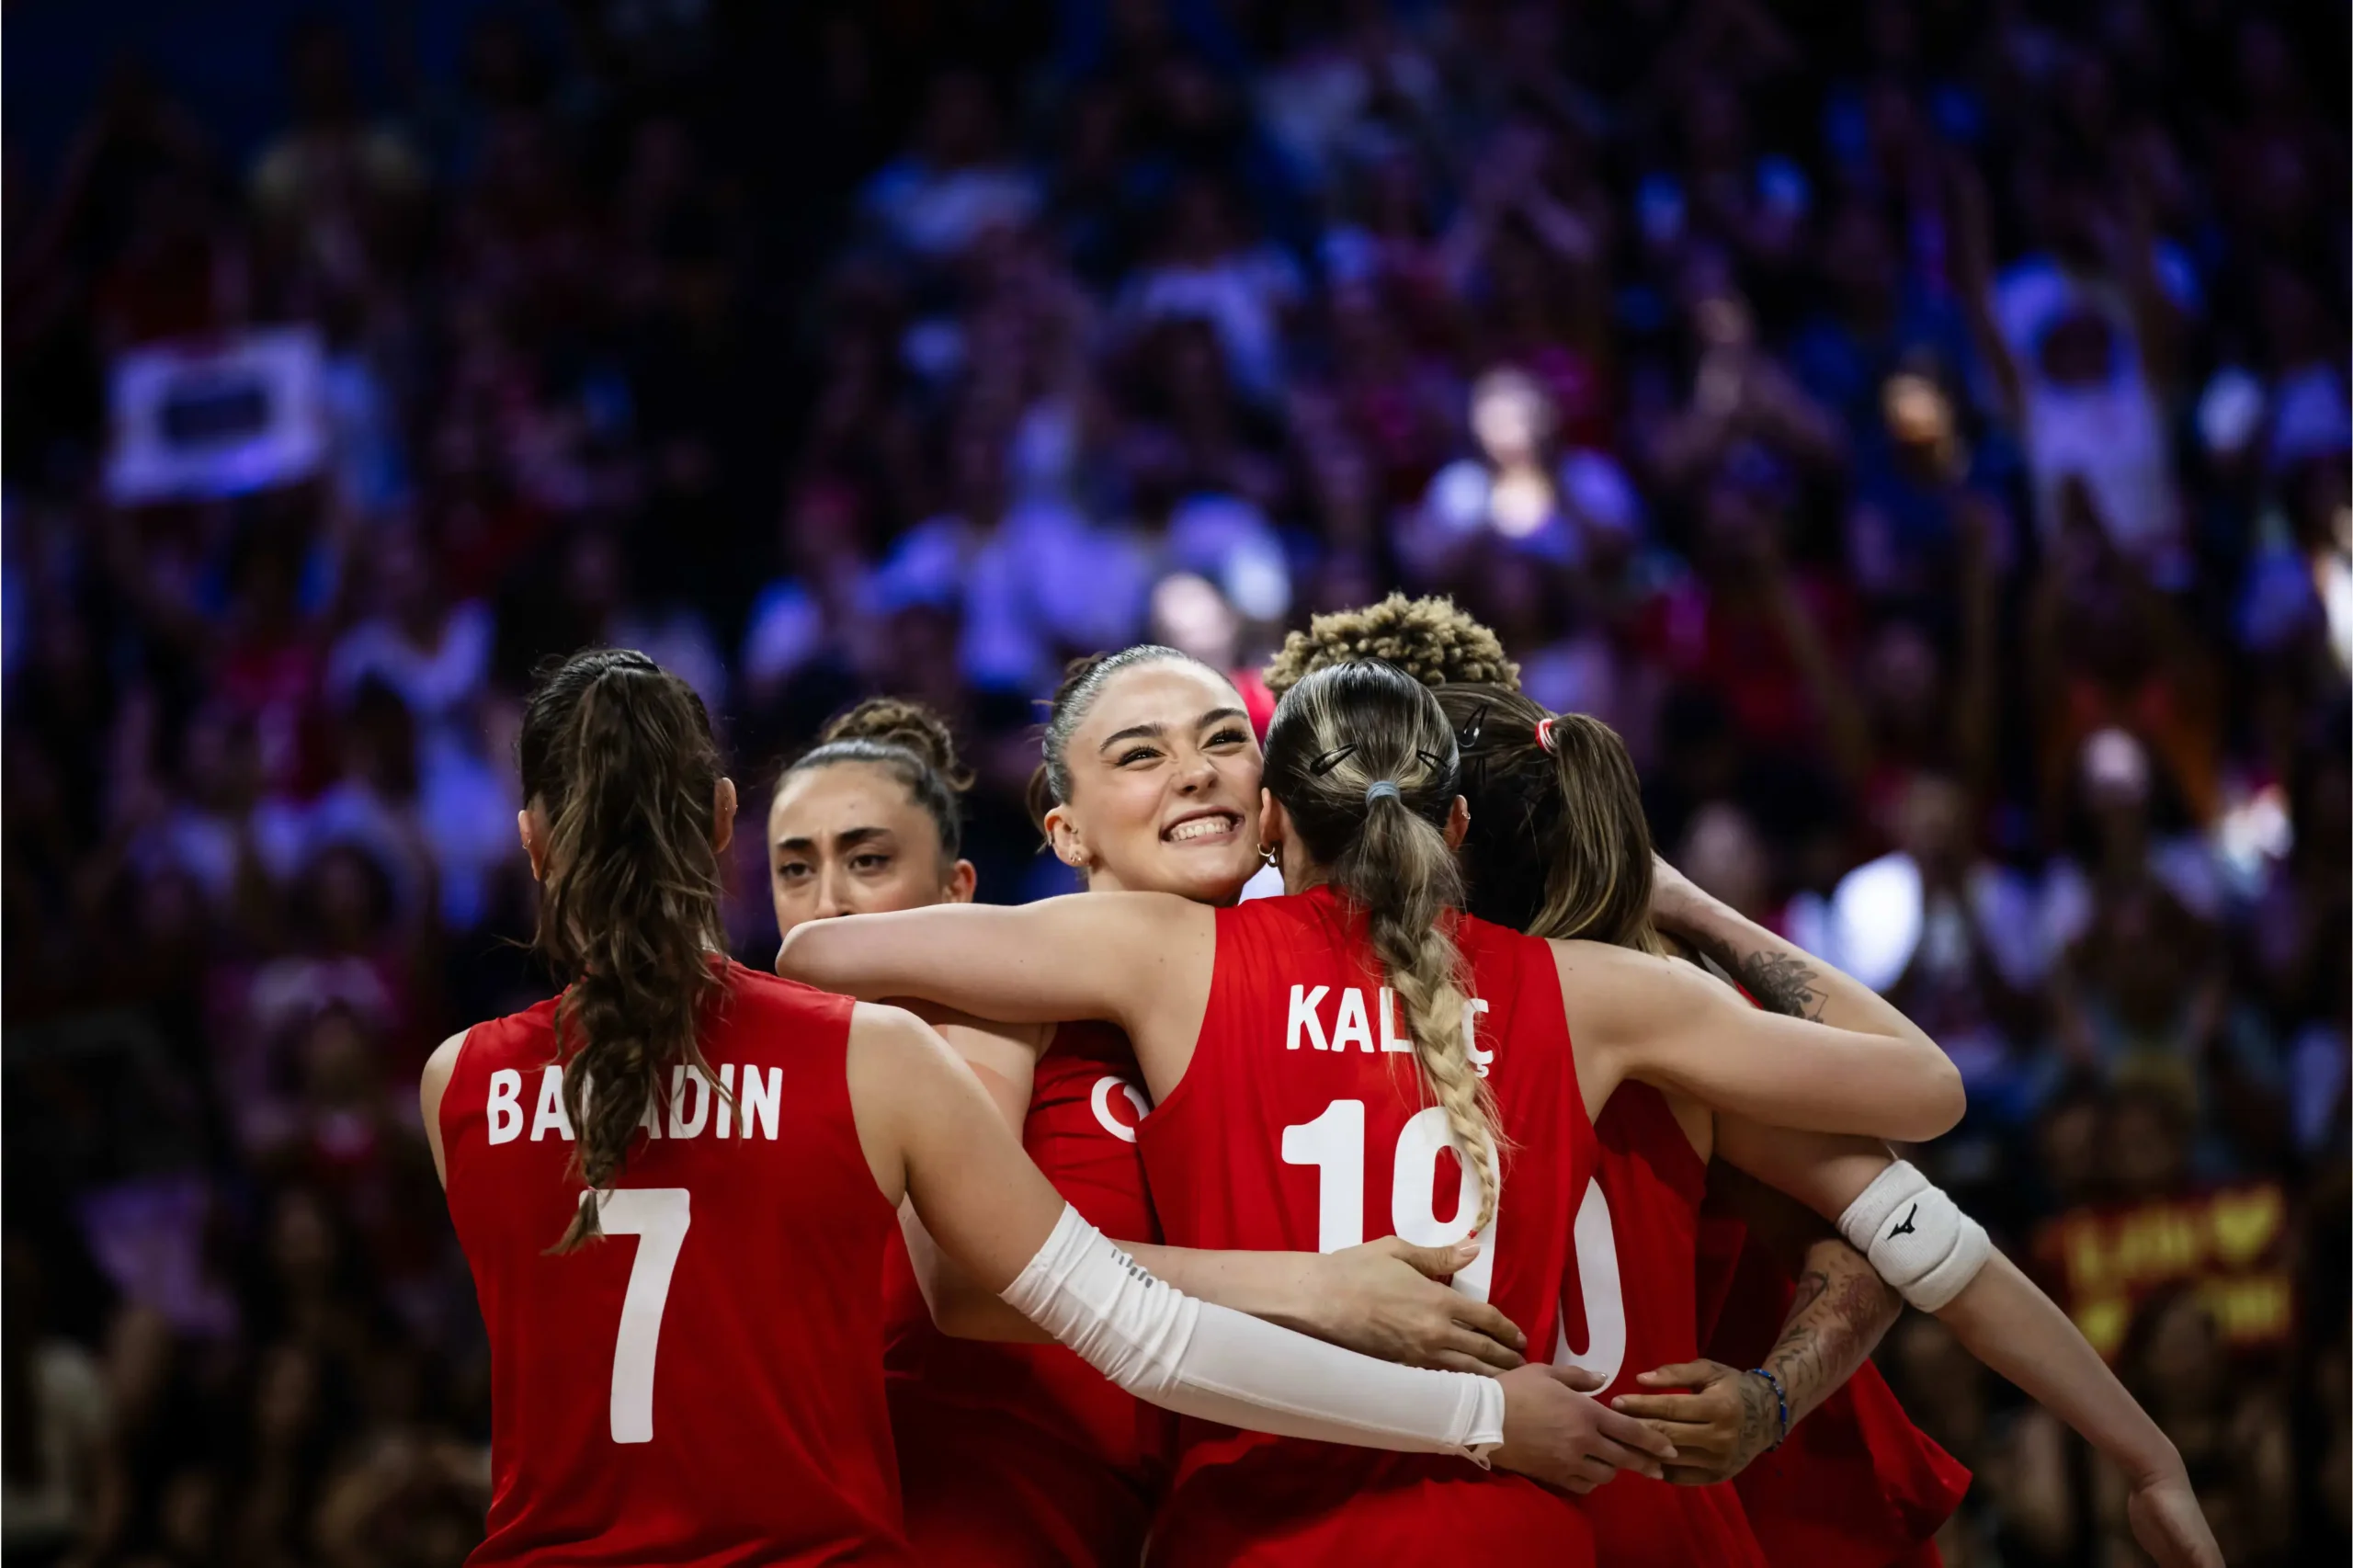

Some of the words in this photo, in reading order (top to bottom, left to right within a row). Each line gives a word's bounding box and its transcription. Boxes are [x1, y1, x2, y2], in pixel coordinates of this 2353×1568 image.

[487, 1063, 783, 1145] BADIN
[1287, 984, 1494, 1078] KALÇ
[1281, 1099, 1500, 1304] 19
[578, 1187, 691, 1444] 7
